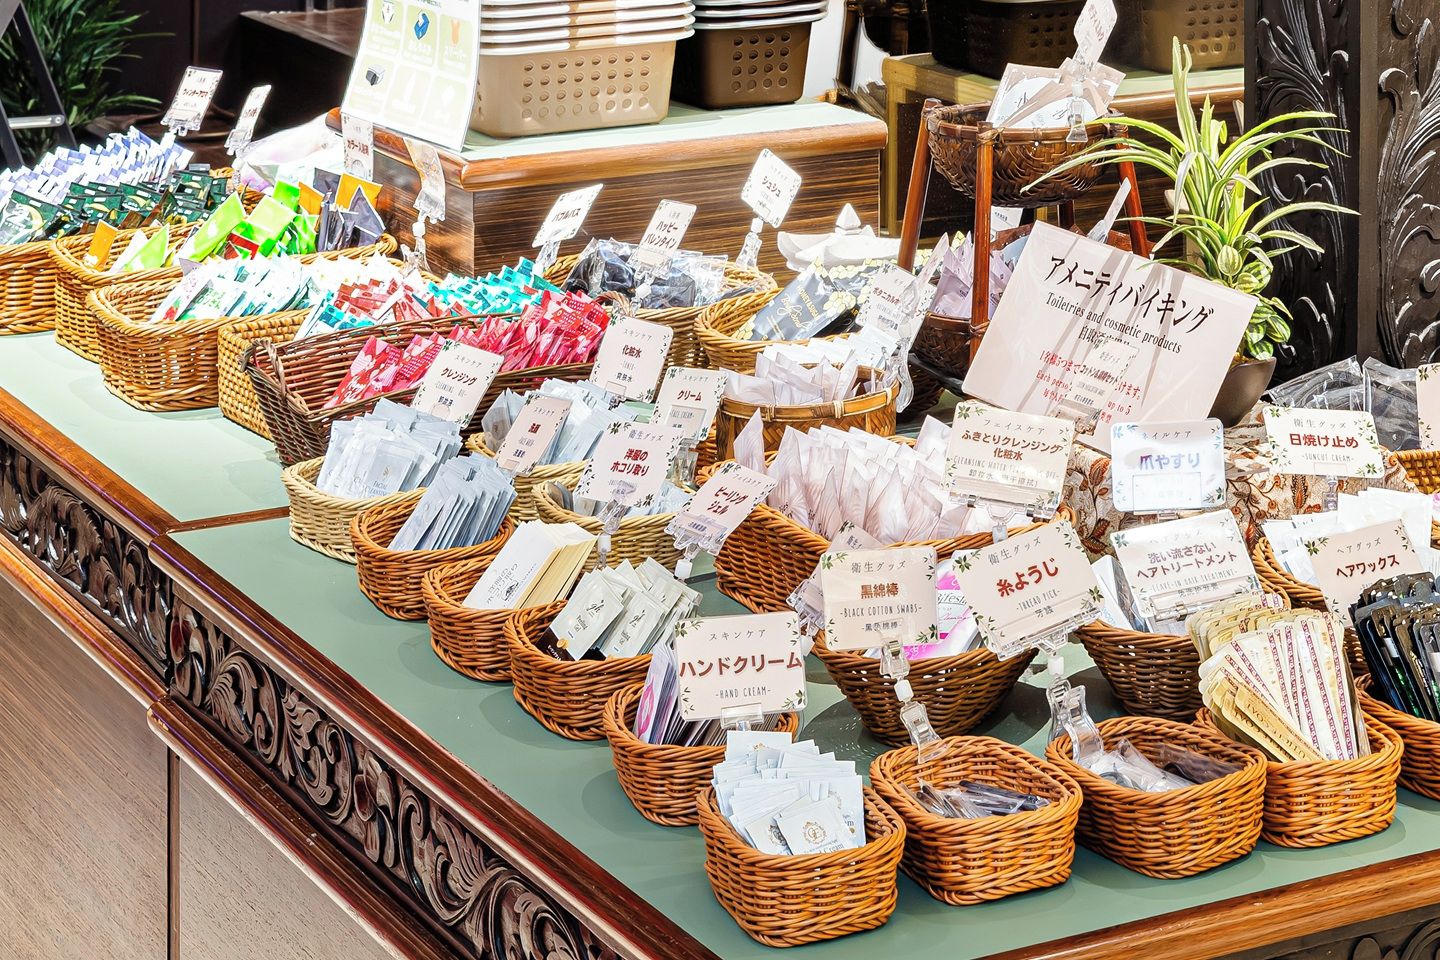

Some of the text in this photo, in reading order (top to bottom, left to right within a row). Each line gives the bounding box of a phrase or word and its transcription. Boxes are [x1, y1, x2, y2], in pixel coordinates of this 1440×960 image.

[762, 175, 782, 198] シュシュ
[656, 220, 678, 233] ハッピー
[1043, 255, 1215, 334] アメニティバイキング
[1045, 292, 1086, 319] Toiletries
[1087, 310, 1103, 324] and
[1104, 313, 1142, 339] cosmetic
[1142, 330, 1183, 355] products
[622, 344, 642, 359] 化粧水
[440, 367, 478, 387] クレンジング
[677, 389, 703, 402] クリーム
[1125, 405, 1132, 416] 5
[984, 419, 1045, 435] フェイスケア
[1293, 418, 1347, 430] 衛生グッズ
[961, 429, 1064, 455] ふきとりクレンジング
[1289, 432, 1359, 449] 日焼け止め
[623, 448, 649, 462] 洋服の
[993, 447, 1024, 461] 化粧水
[1139, 452, 1201, 471] 爪やすり
[610, 460, 650, 477] ホコリ取り
[987, 536, 1042, 566] 衛生グッズ
[1147, 541, 1217, 564] 洗い流さない
[1336, 536, 1382, 554] ヘアグッズ
[851, 560, 906, 574] 衛生グッズ
[1137, 551, 1238, 579] ヘアトリートメント
[1335, 554, 1400, 578] ヘアワックス
[996, 557, 1059, 598] 糸ようじ
[860, 582, 899, 600] 黒綿棒
[867, 605, 893, 617] COTTON
[896, 603, 922, 615] SWABS-
[708, 628, 767, 642] スキンケア
[679, 651, 803, 678] ハンドクリーム
[715, 686, 771, 699] -HAND CREAM-
